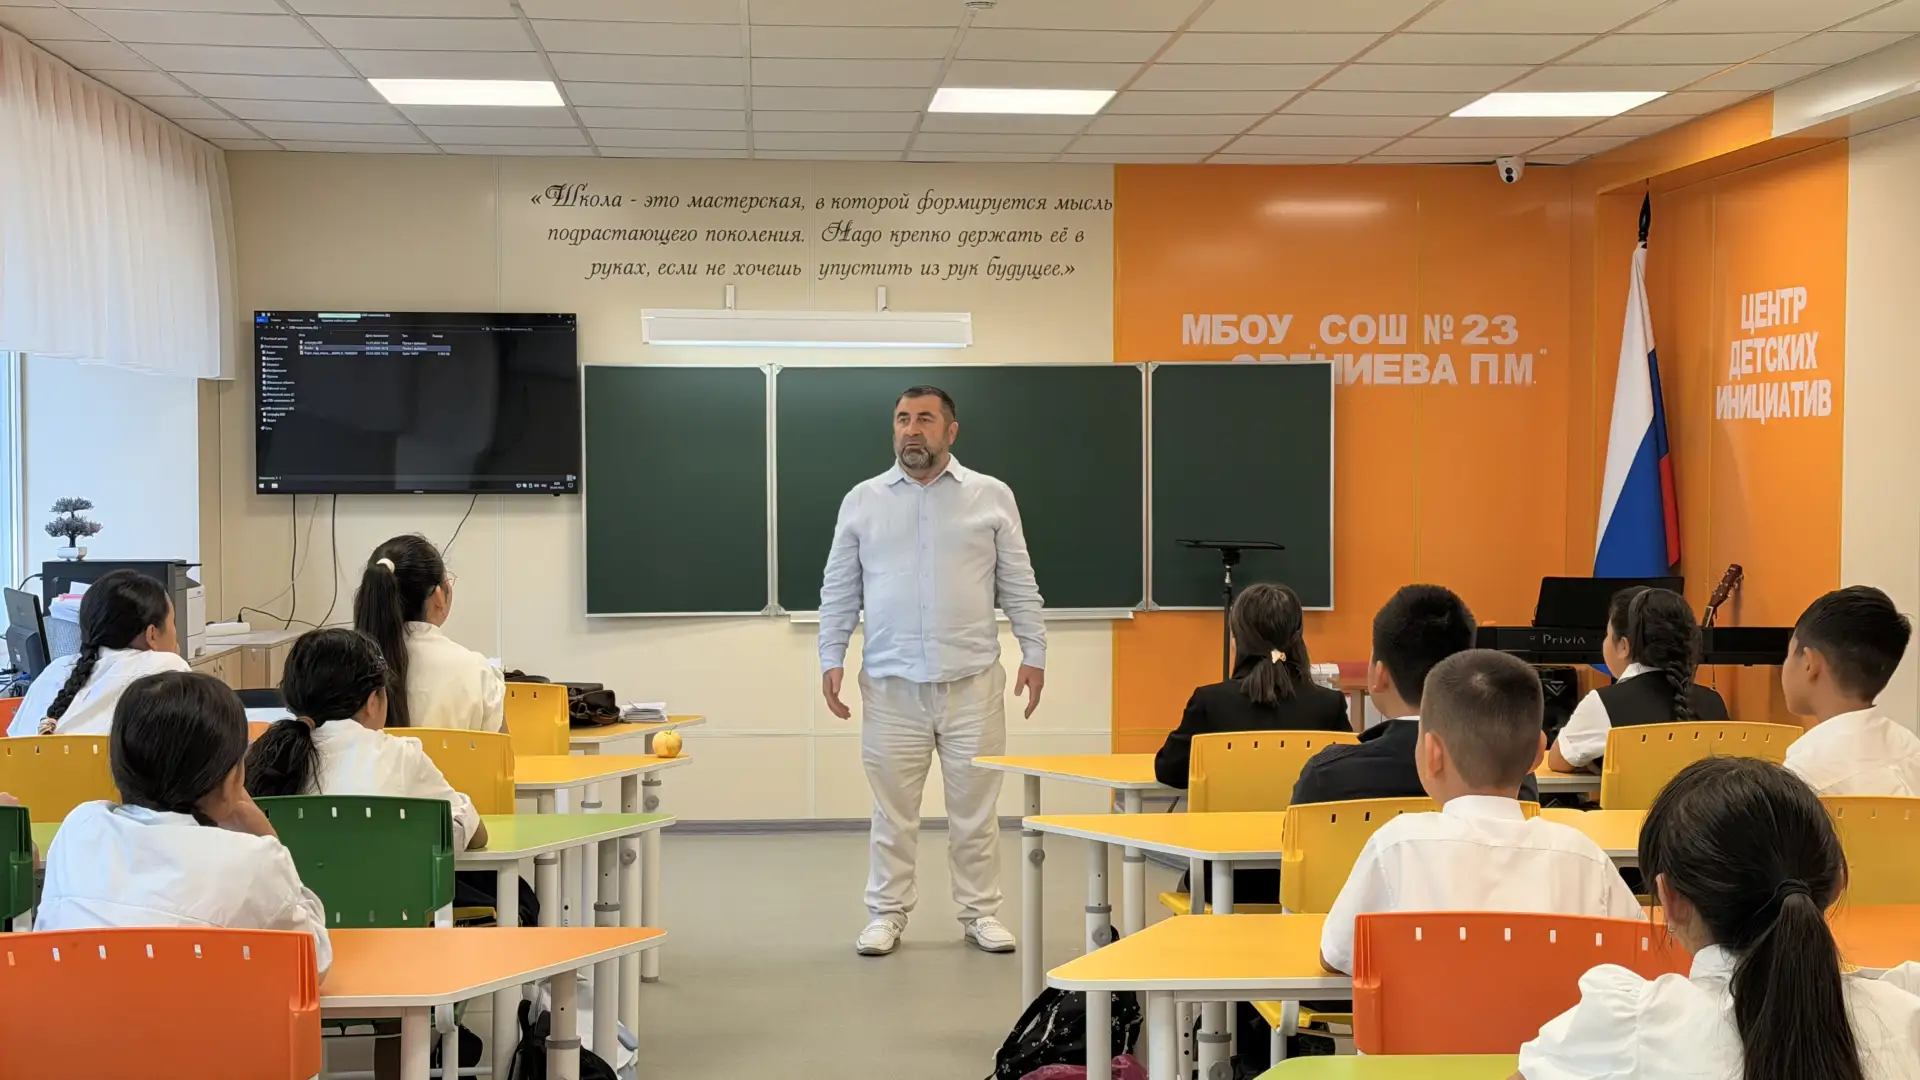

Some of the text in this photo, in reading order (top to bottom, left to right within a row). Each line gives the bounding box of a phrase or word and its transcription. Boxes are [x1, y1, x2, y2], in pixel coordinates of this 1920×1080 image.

[643, 195, 680, 209] это
[686, 195, 806, 214] мастерская,
[815, 197, 825, 210] в
[830, 192, 910, 215] которой
[916, 188, 1048, 216] формируется
[1054, 197, 1113, 211] мысль
[547, 220, 1086, 248] подрастающего поколения. Надо крепко держать её в
[584, 262, 651, 280] руках,
[657, 263, 698, 277] если
[705, 262, 727, 277] не
[733, 262, 803, 277] хочешь
[817, 263, 913, 281] упустить
[920, 263, 941, 278] из
[942, 263, 979, 281] рук
[1741, 286, 1808, 336] ЦЕНТР
[1182, 313, 1294, 346] МБОУ
[1423, 313, 1454, 345] №
[1460, 313, 1519, 346] 23
[1729, 331, 1819, 381] ДЕТСКИХ
[1716, 379, 1832, 425] ИНИЦИАТИВ
